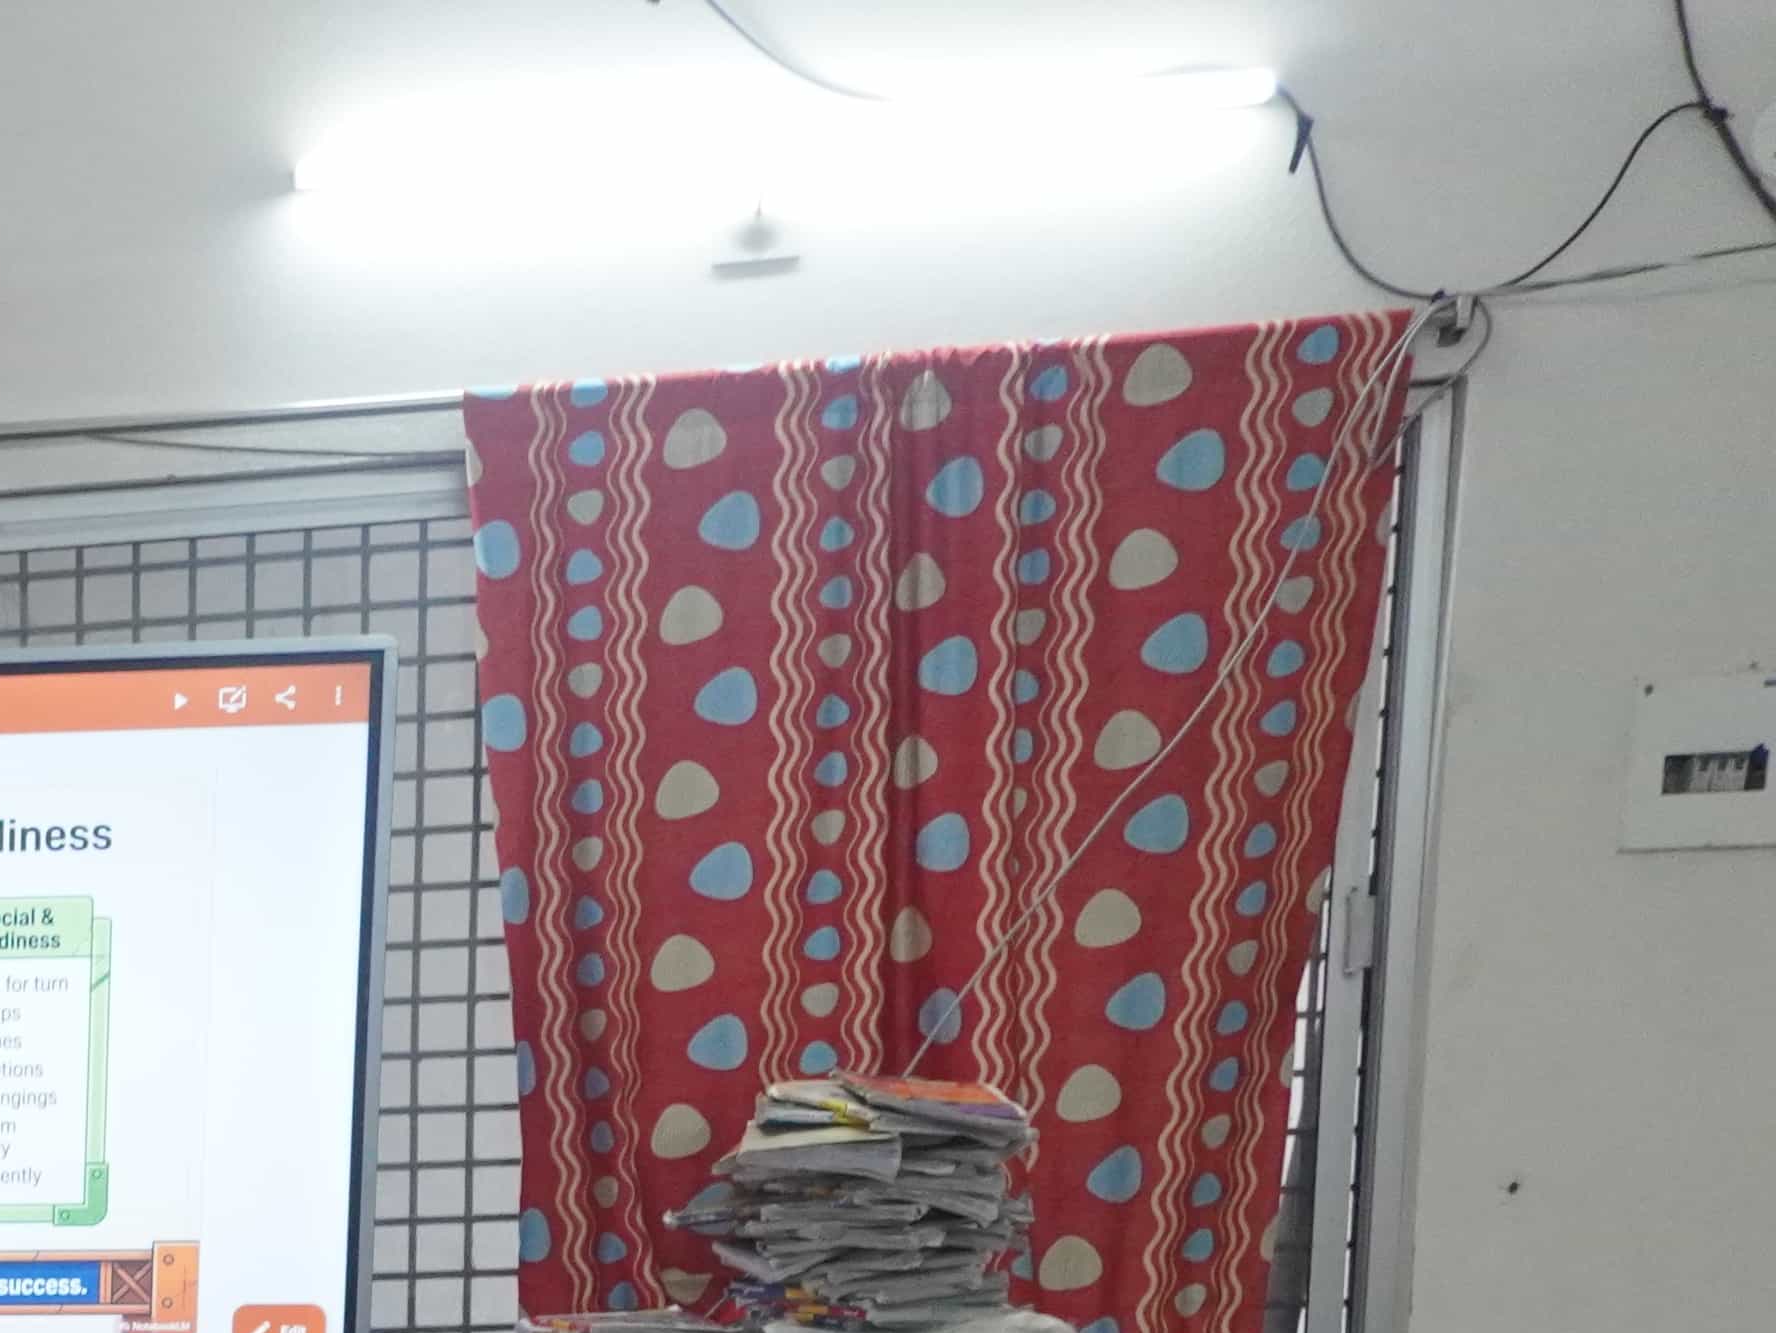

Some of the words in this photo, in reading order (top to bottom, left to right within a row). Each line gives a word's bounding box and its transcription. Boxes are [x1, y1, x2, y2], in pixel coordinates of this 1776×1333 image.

[42, 908, 54, 926] &
[6, 976, 28, 992] for
[35, 977, 68, 992] turn
